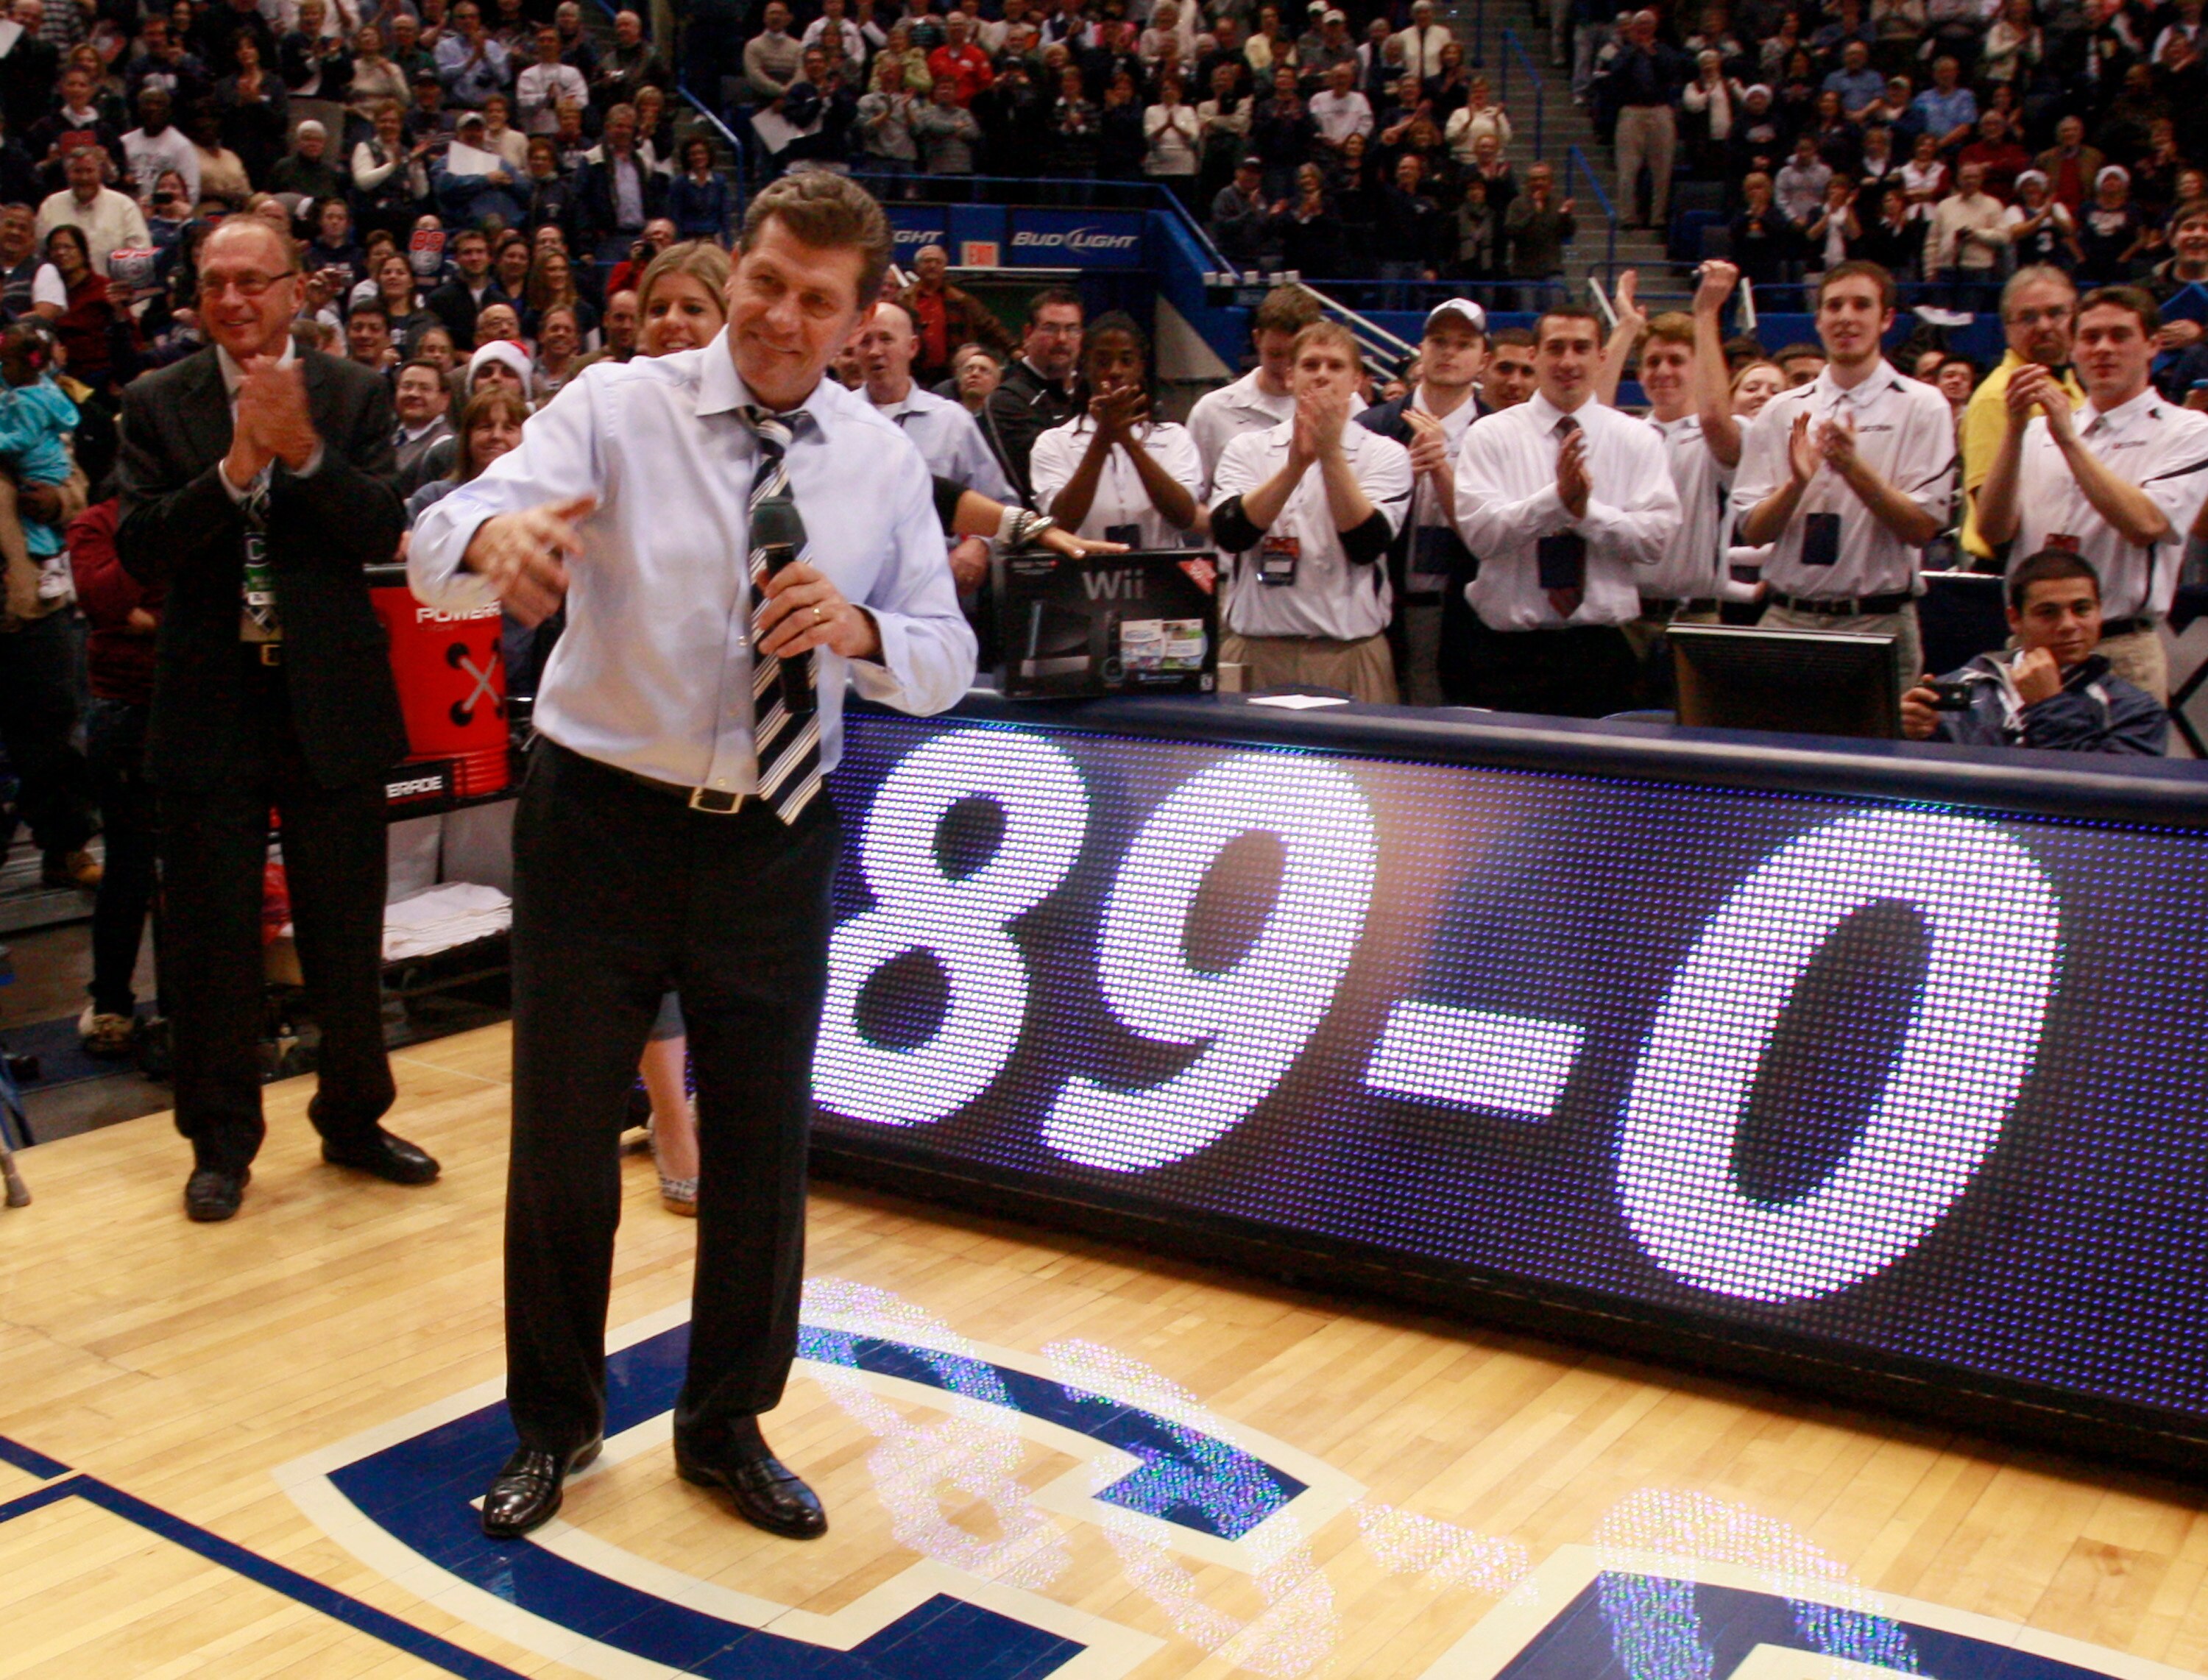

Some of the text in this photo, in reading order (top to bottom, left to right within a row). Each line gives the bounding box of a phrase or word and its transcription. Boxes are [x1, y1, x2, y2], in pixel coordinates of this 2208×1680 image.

[1011, 232, 1139, 248] BUD LIGHT
[1082, 569, 1143, 600] Wii
[812, 727, 2063, 1304] 89-0
